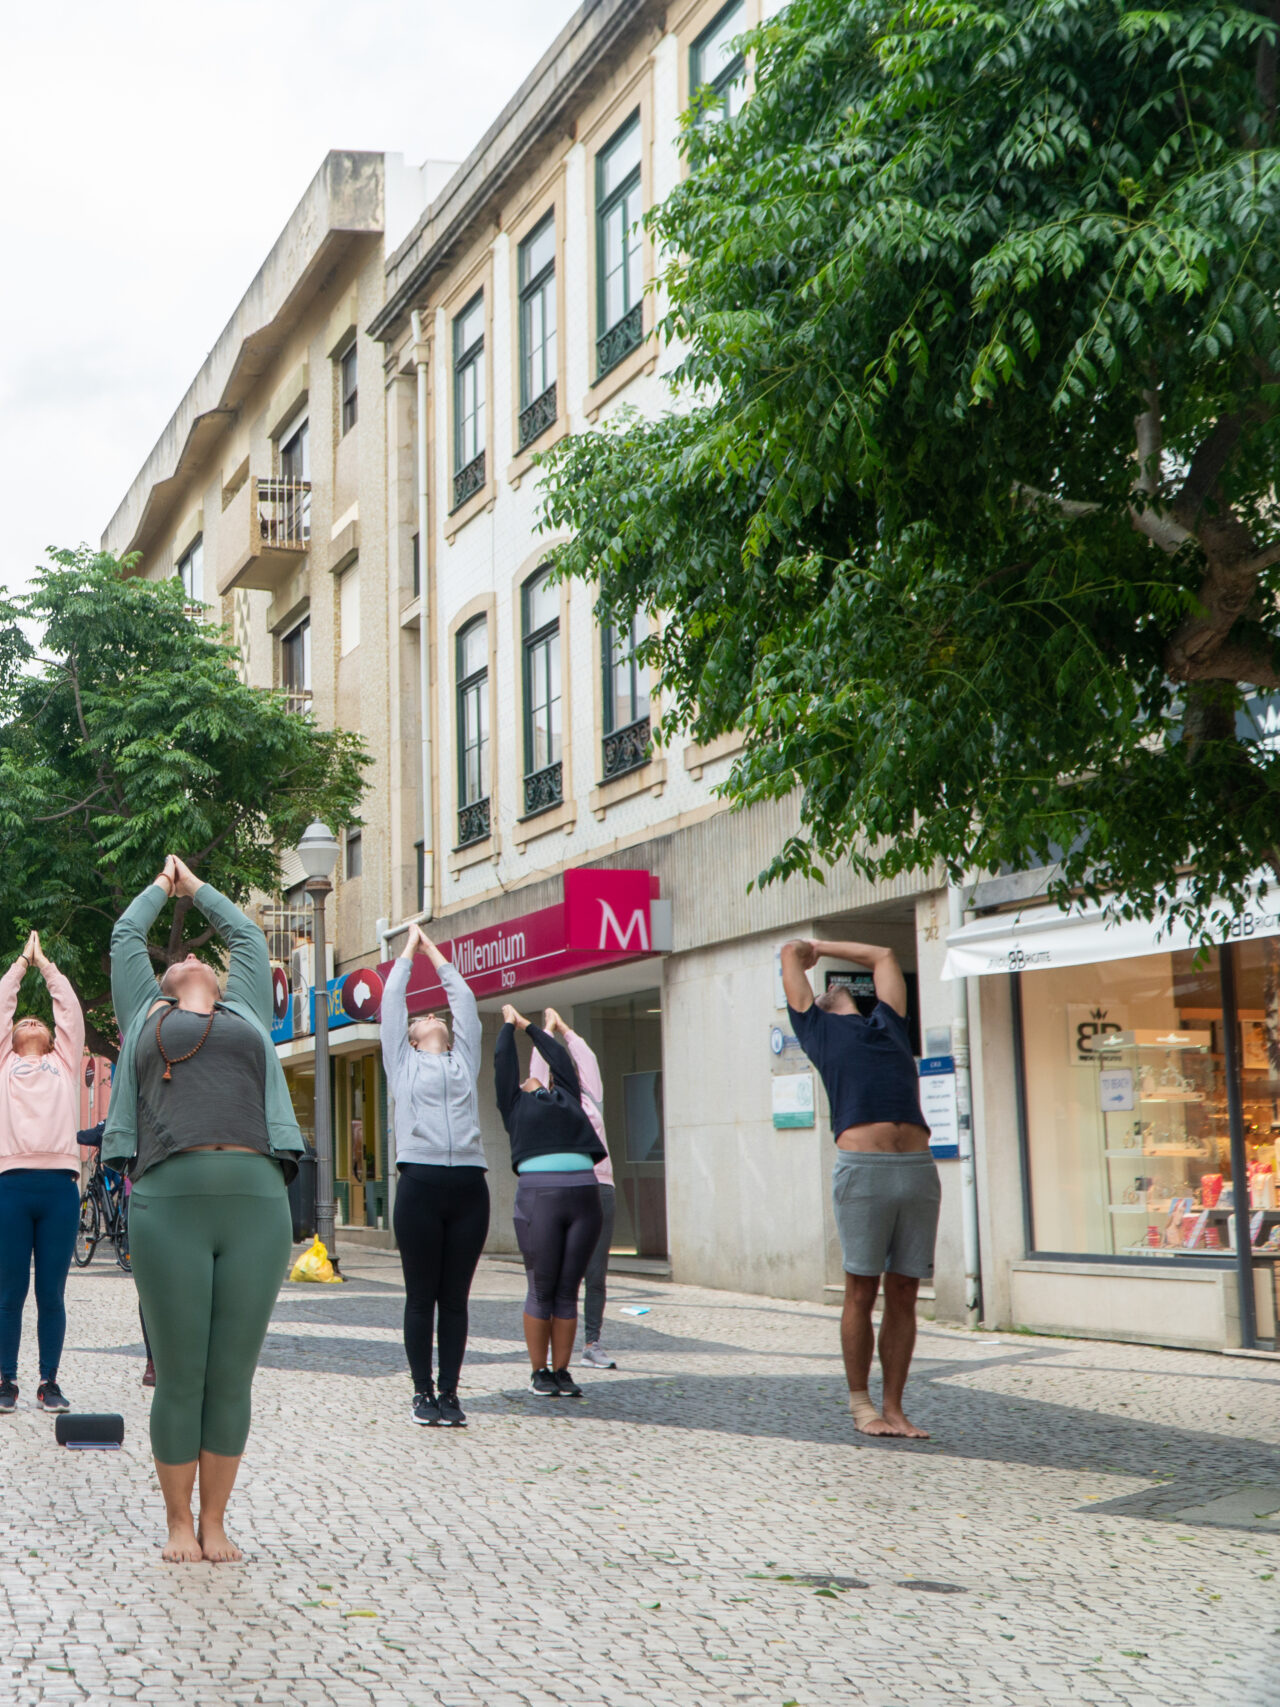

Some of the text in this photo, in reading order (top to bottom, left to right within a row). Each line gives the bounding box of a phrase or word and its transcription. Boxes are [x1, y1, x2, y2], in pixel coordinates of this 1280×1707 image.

[596, 898, 650, 951] M
[450, 930, 526, 975] Millennium
[501, 969, 516, 988] bcp
